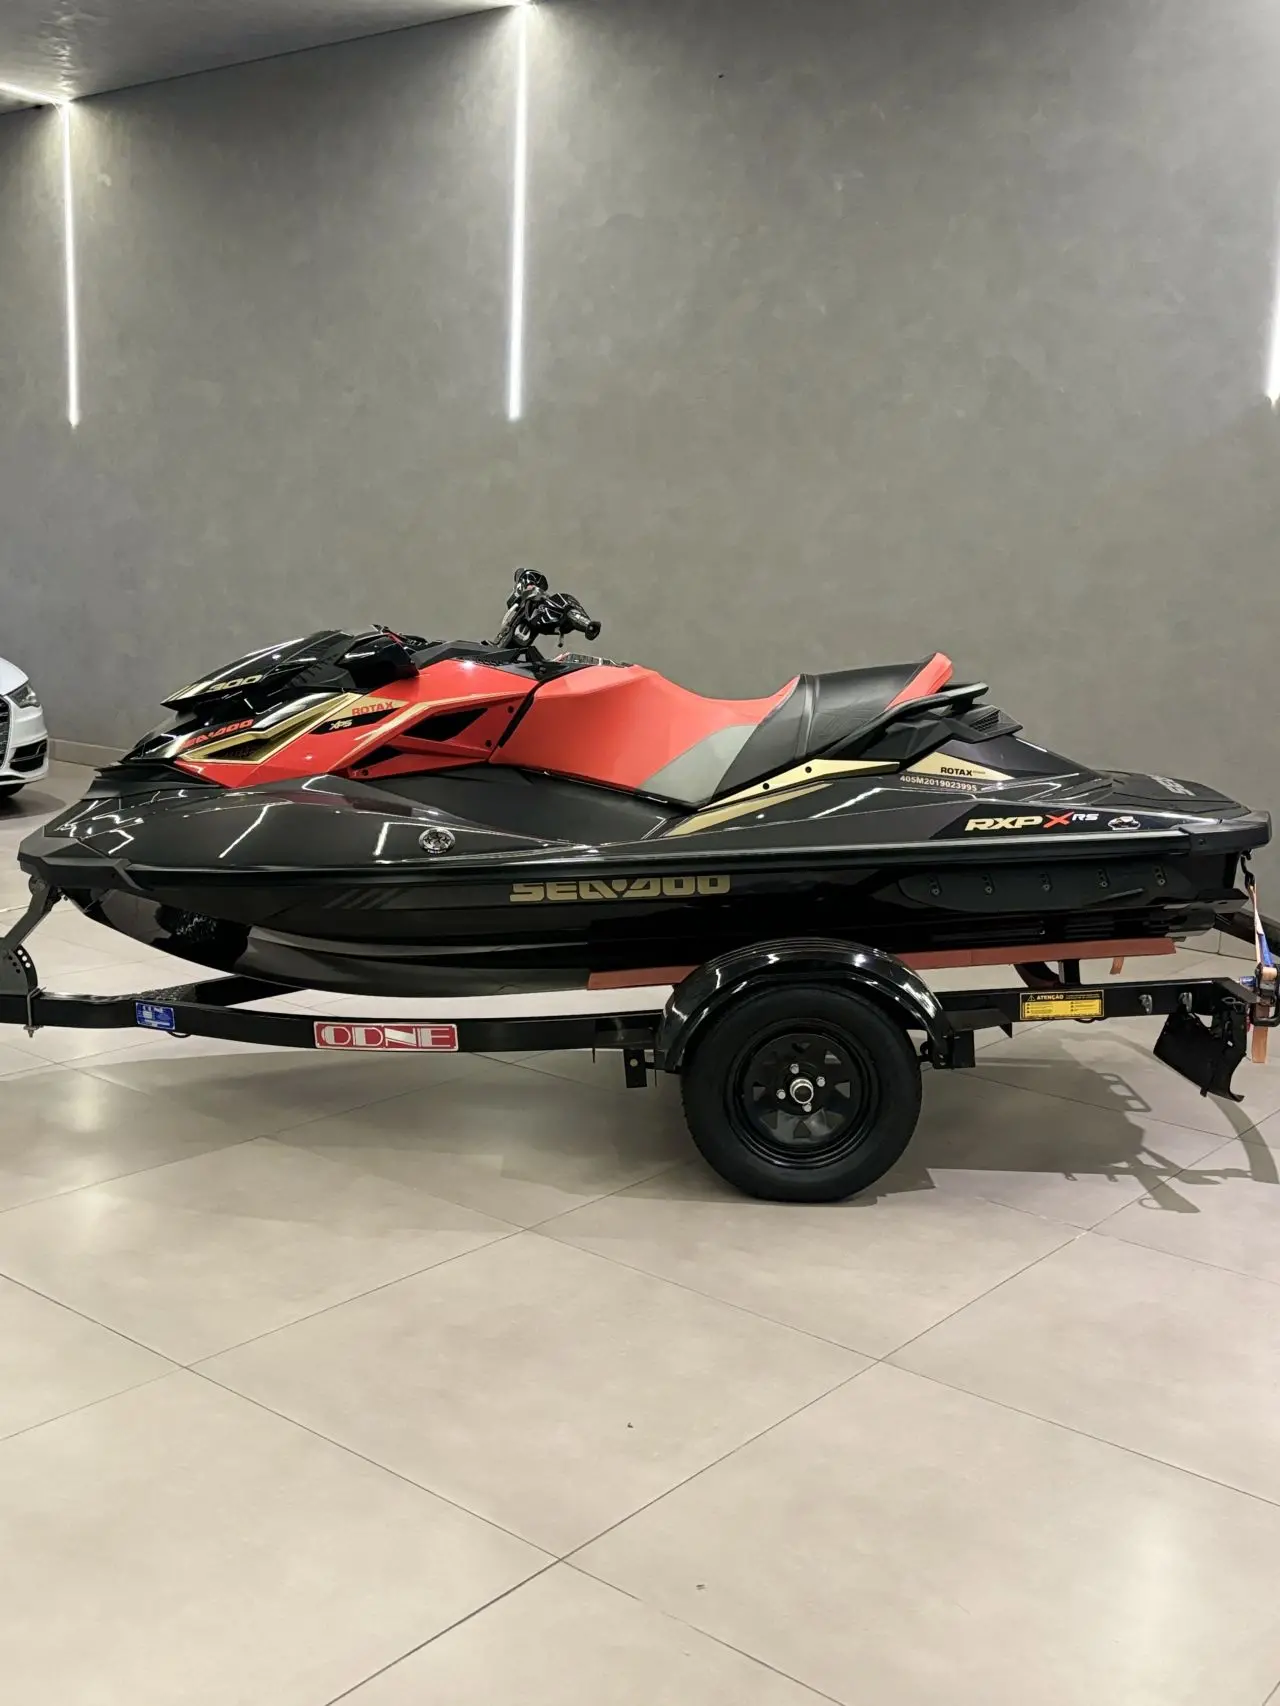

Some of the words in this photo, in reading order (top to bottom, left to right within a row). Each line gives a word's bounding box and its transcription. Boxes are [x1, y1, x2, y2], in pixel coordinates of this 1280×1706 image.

[208, 674, 262, 692] 300
[351, 701, 393, 716] ROTAX
[940, 766, 973, 777] ROTAX
[900, 775, 977, 792] 405M2019023995
[964, 815, 1043, 831] RXP
[1072, 813, 1099, 821] RS
[321, 1025, 451, 1048] ODNE
